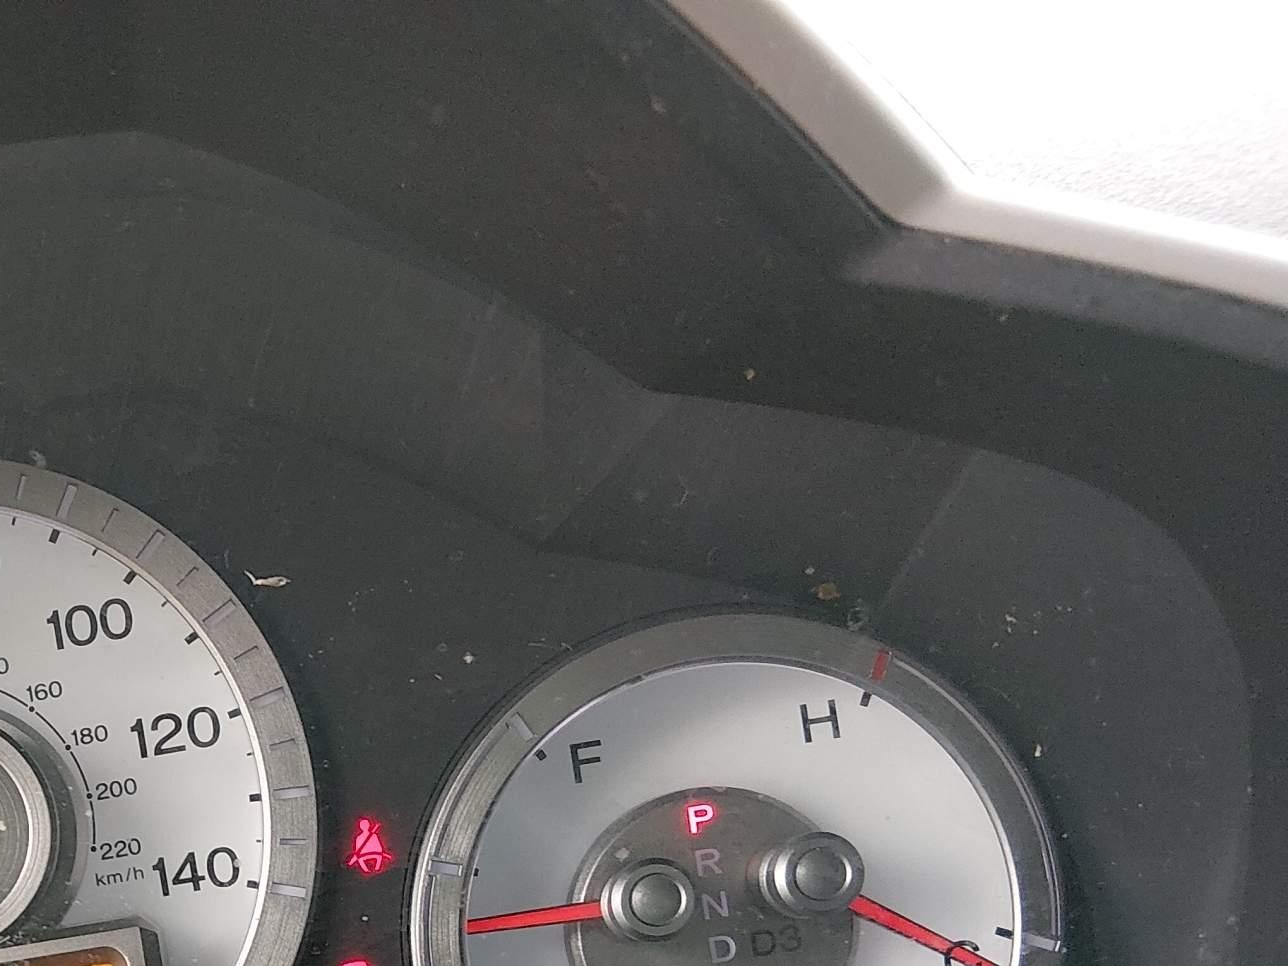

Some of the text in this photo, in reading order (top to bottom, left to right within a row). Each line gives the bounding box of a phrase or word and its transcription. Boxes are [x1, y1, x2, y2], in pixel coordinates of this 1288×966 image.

[46, 598, 133, 650] 100
[26, 681, 63, 702] 160
[130, 706, 221, 759] 120
[800, 699, 841, 742] H
[71, 725, 109, 747] 180
[569, 739, 602, 783] F
[96, 778, 138, 801] 200
[688, 804, 714, 833] P
[100, 838, 142, 860] 220
[694, 848, 721, 876] R
[95, 864, 145, 886] km/h
[152, 846, 240, 897] 140
[702, 891, 730, 920] N
[708, 926, 803, 964] D D3
